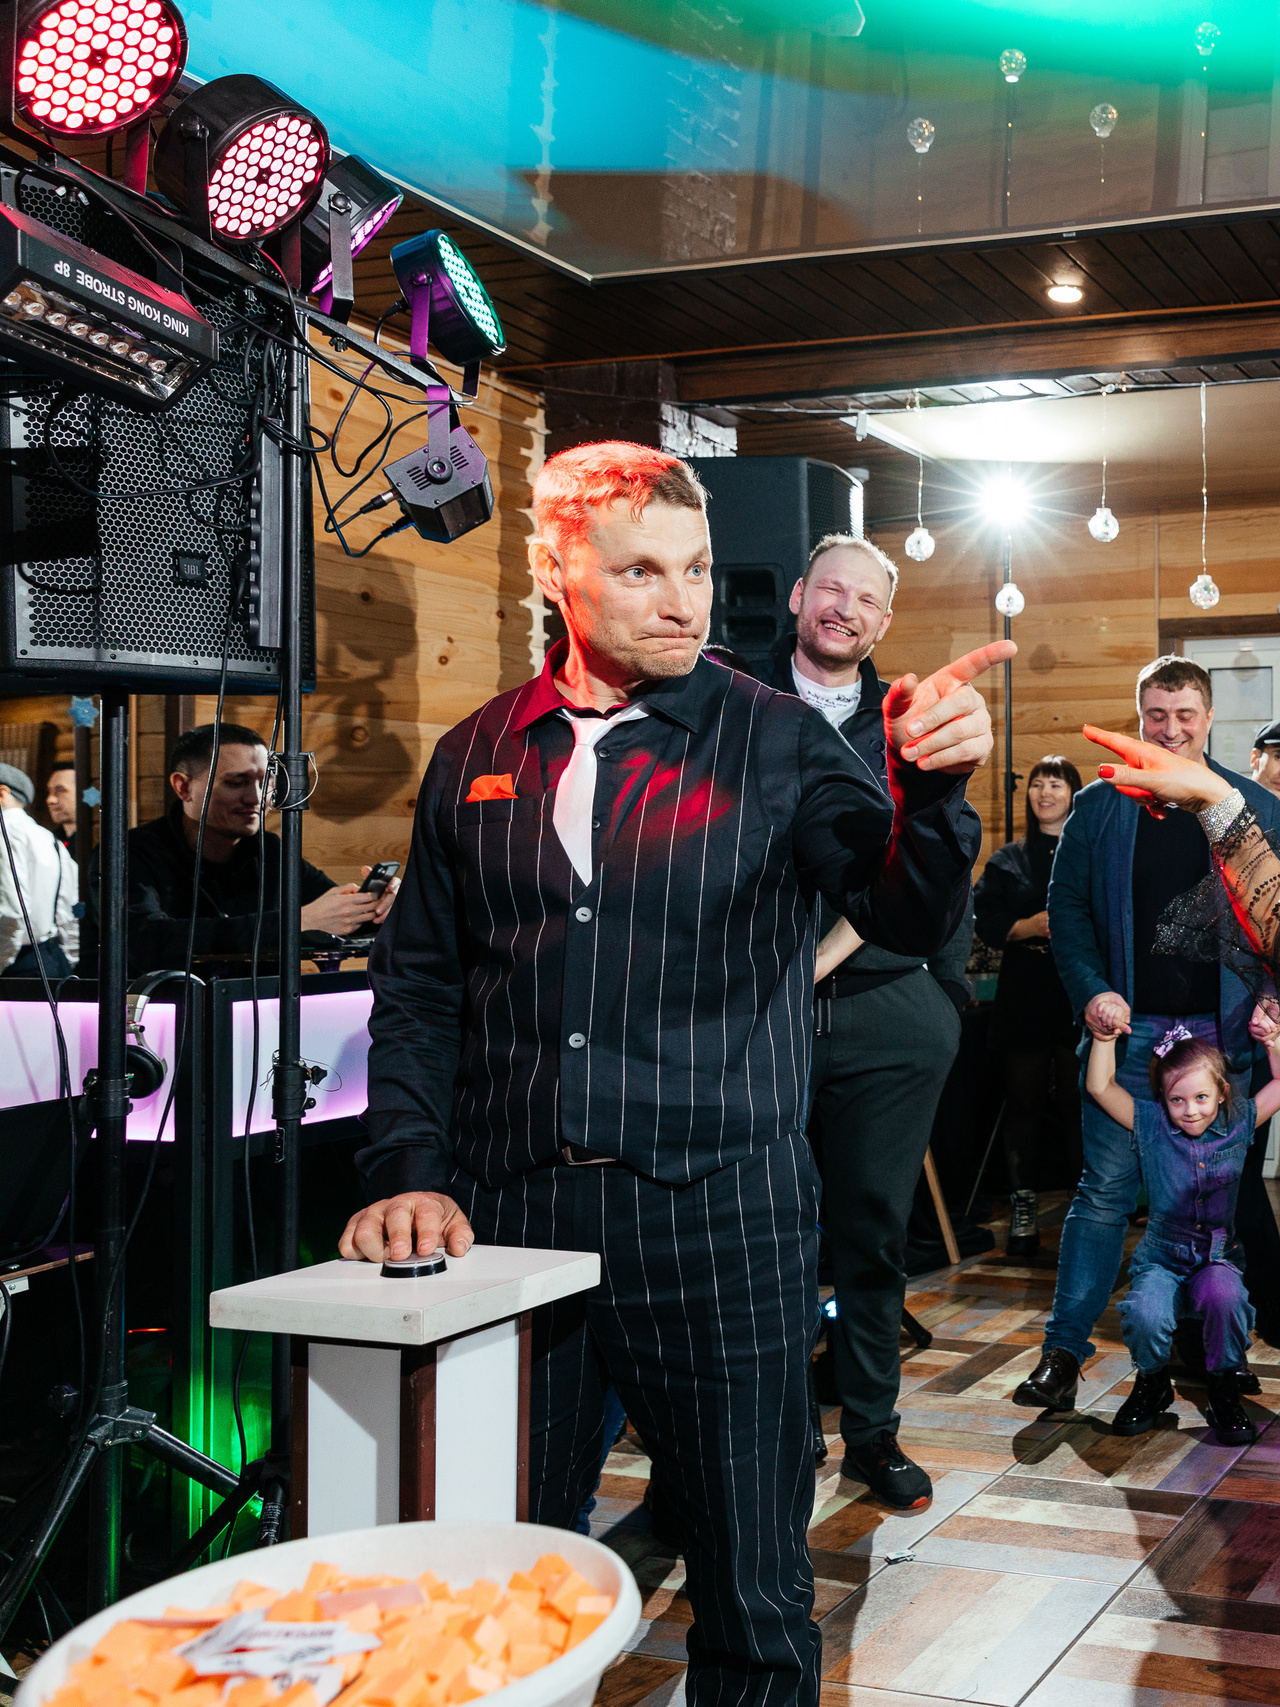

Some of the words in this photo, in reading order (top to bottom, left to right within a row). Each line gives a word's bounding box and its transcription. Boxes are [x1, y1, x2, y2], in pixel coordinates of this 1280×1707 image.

[53, 260, 71, 278] 8P
[76, 268, 126, 306] STROBE
[127, 296, 161, 323] KONG
[163, 313, 190, 338] KING
[184, 564, 201, 576] JBL
